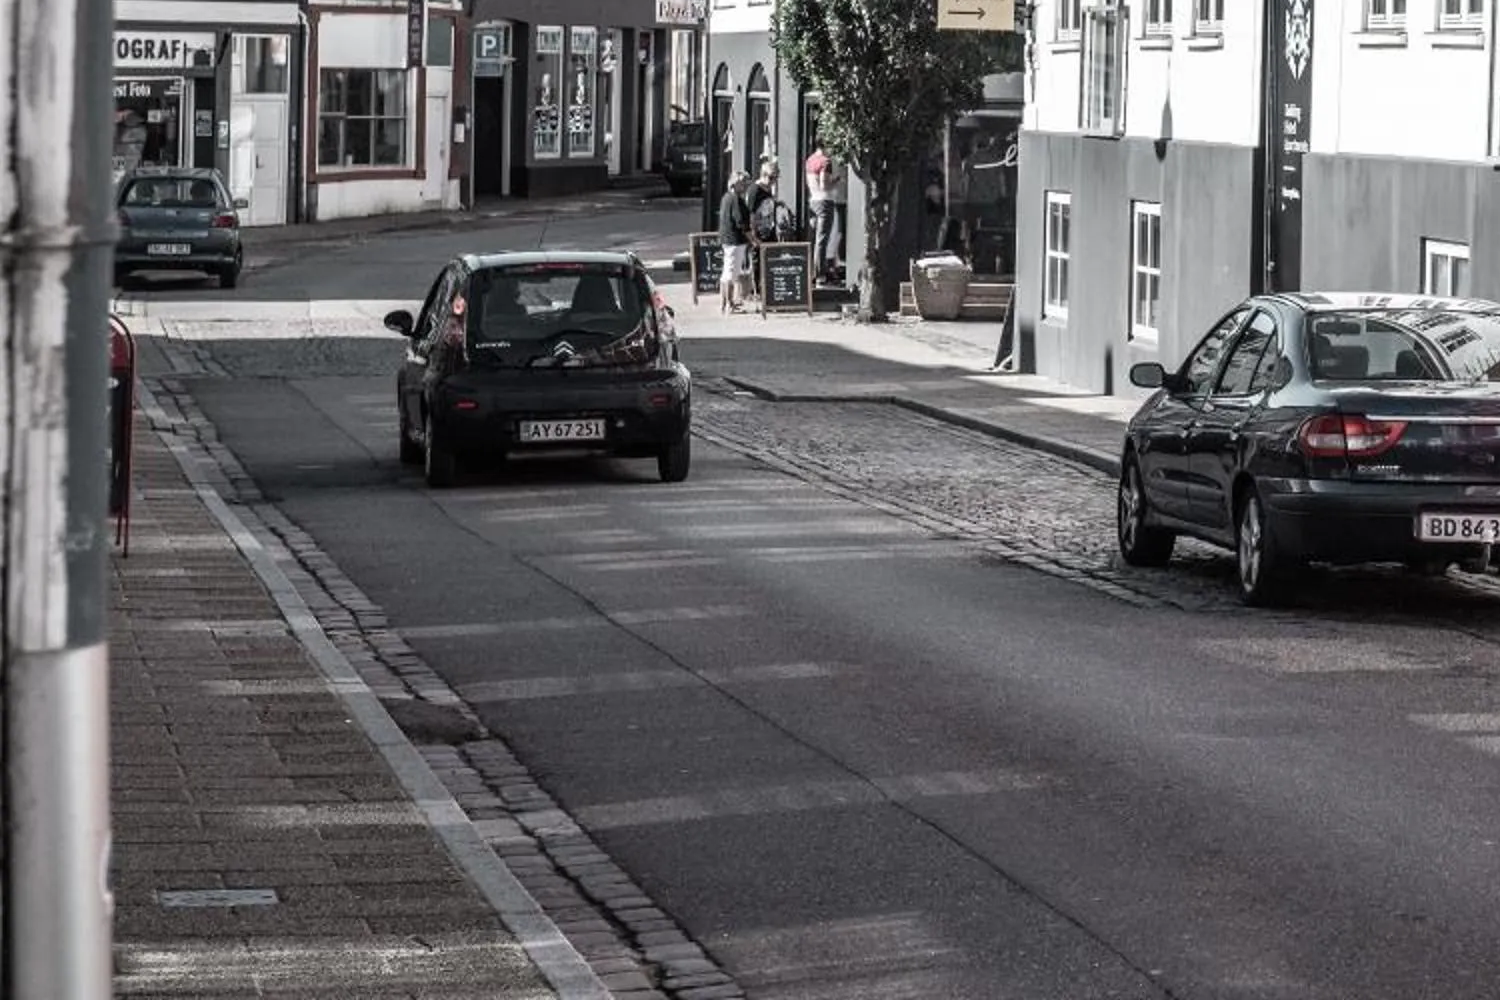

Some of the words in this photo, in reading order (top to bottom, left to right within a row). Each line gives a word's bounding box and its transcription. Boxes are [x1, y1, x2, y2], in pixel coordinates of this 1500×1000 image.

[481, 35, 497, 57] P
[531, 423, 551, 437] AY
[555, 423, 573, 437] 67
[575, 422, 600, 437] 251
[1430, 518, 1457, 537] BD
[1461, 519, 1485, 538] 84
